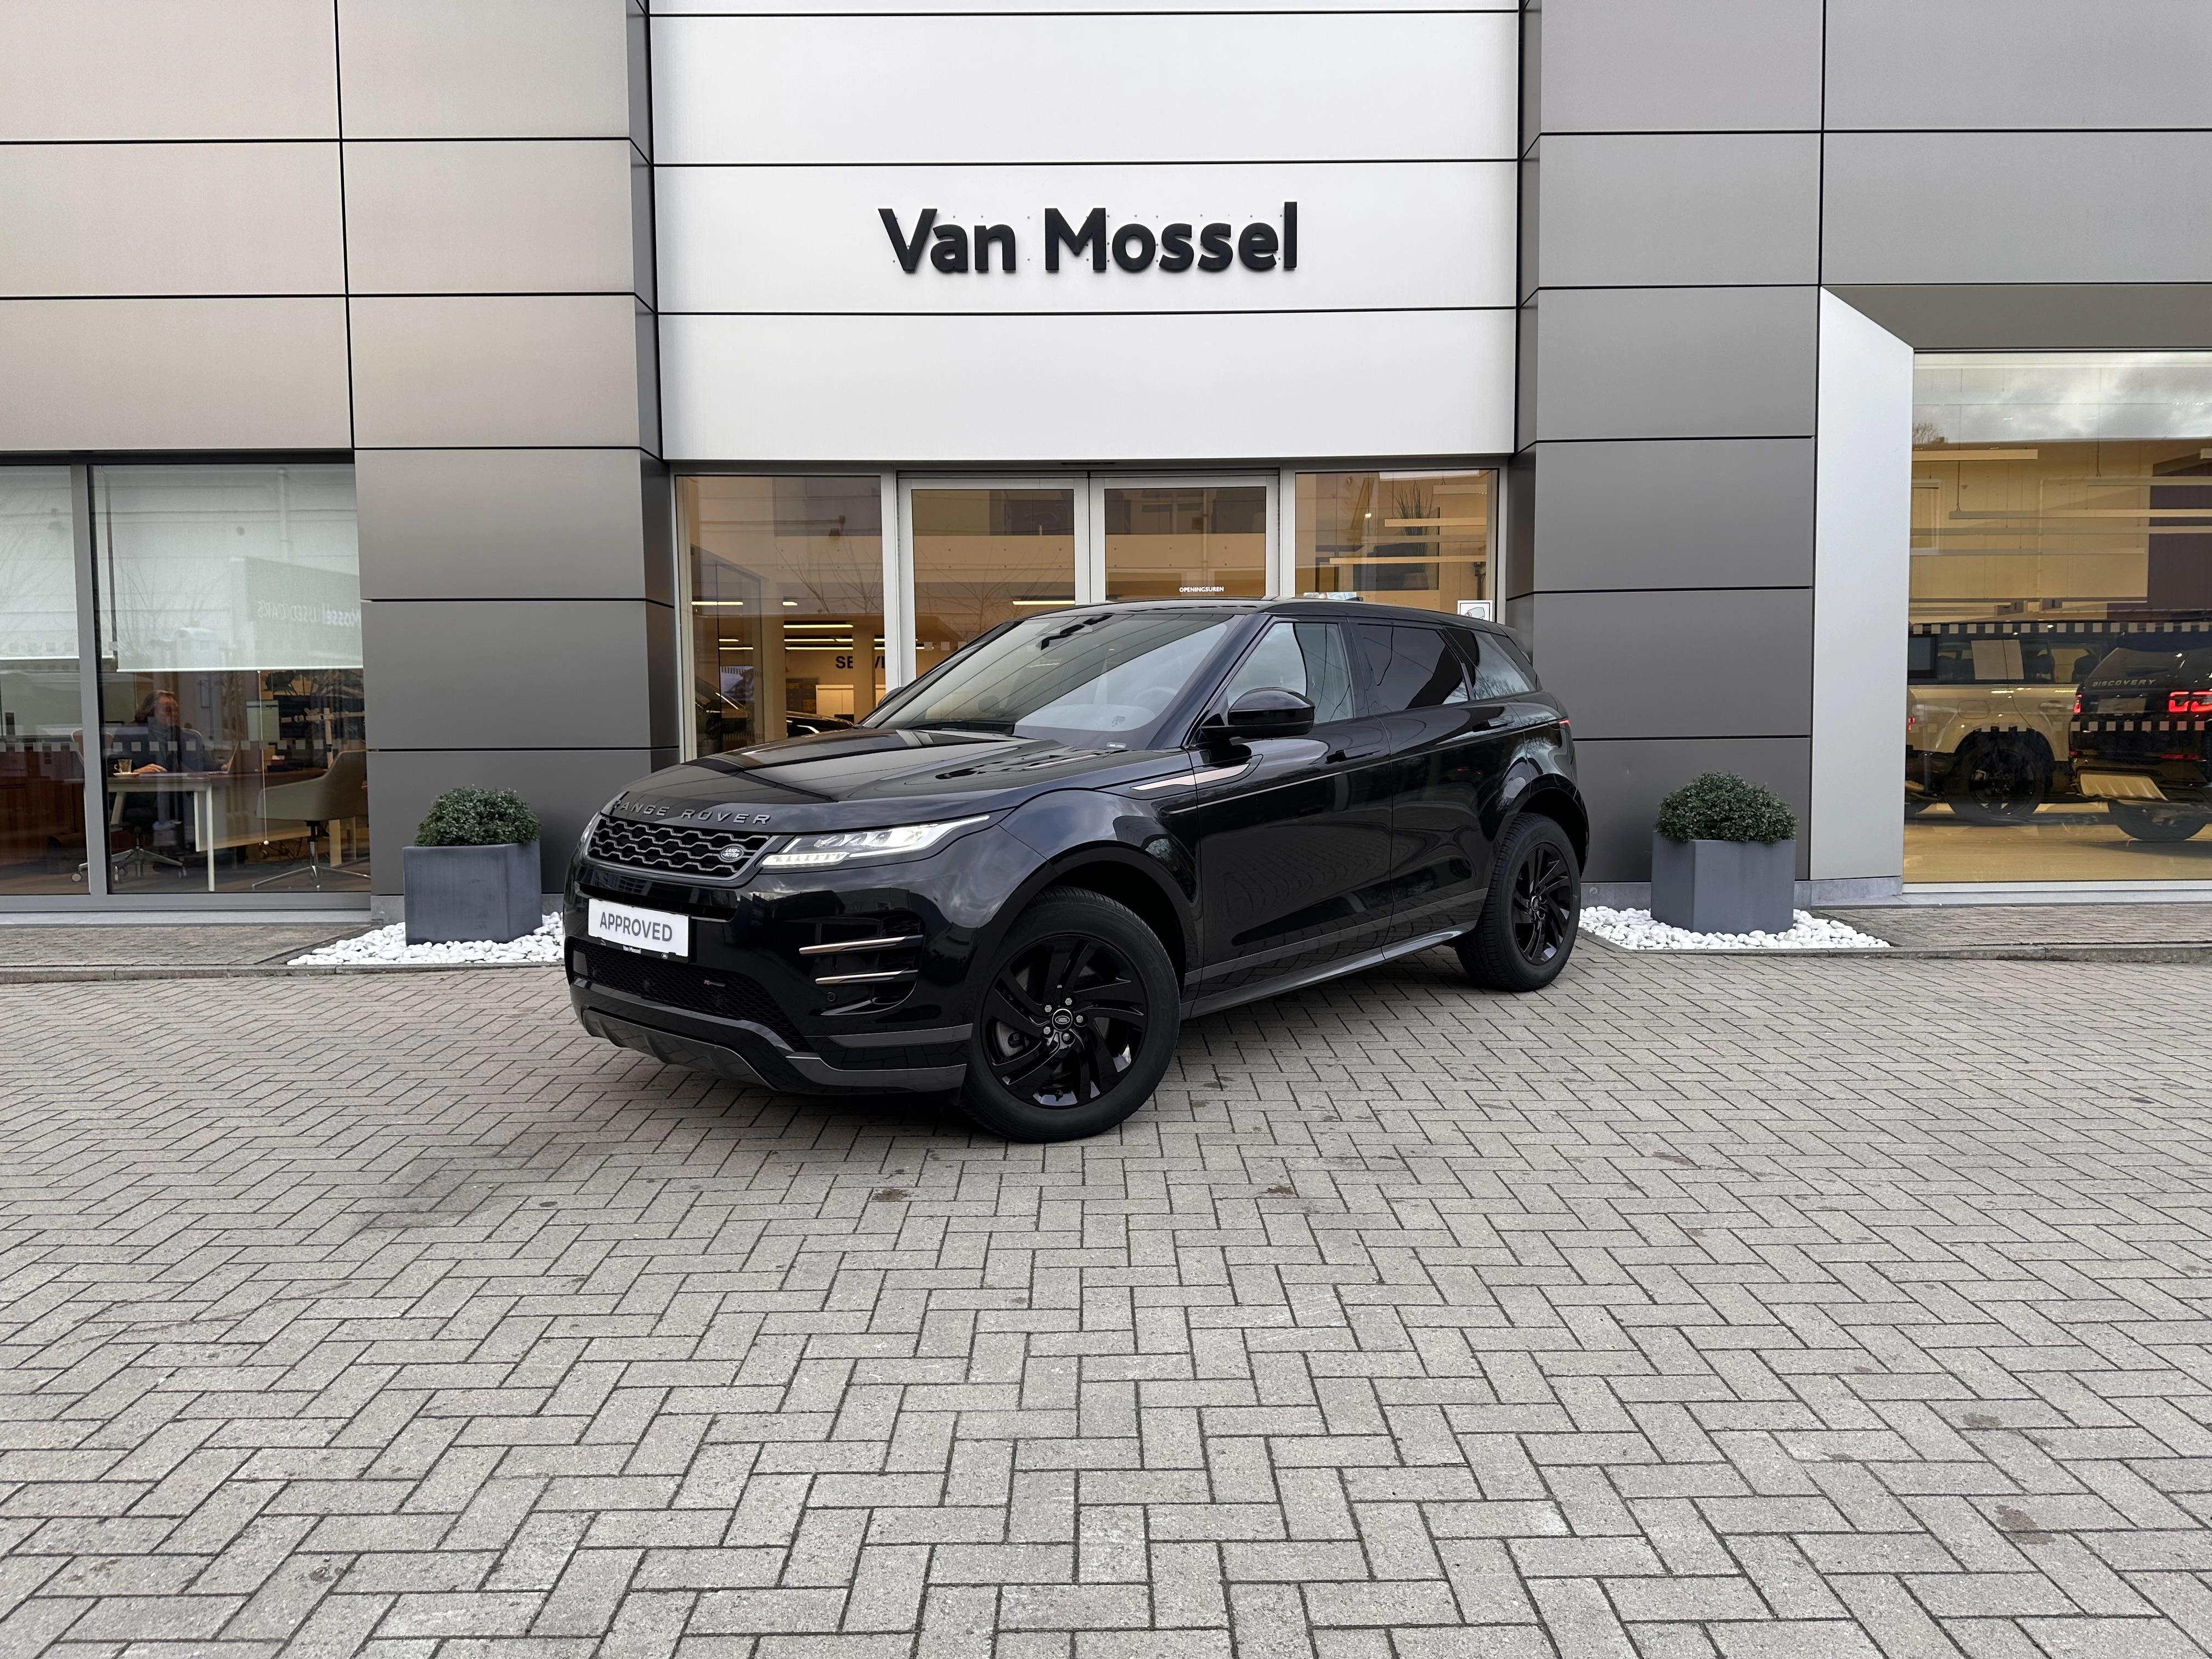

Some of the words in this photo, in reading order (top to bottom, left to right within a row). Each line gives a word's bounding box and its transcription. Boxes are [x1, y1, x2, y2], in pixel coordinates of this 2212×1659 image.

[878, 207, 1016, 272] Van
[1044, 201, 1297, 272] Mossel
[612, 799, 670, 816] RANGE
[680, 809, 771, 825] ROVER
[600, 912, 672, 942] APPROVED
